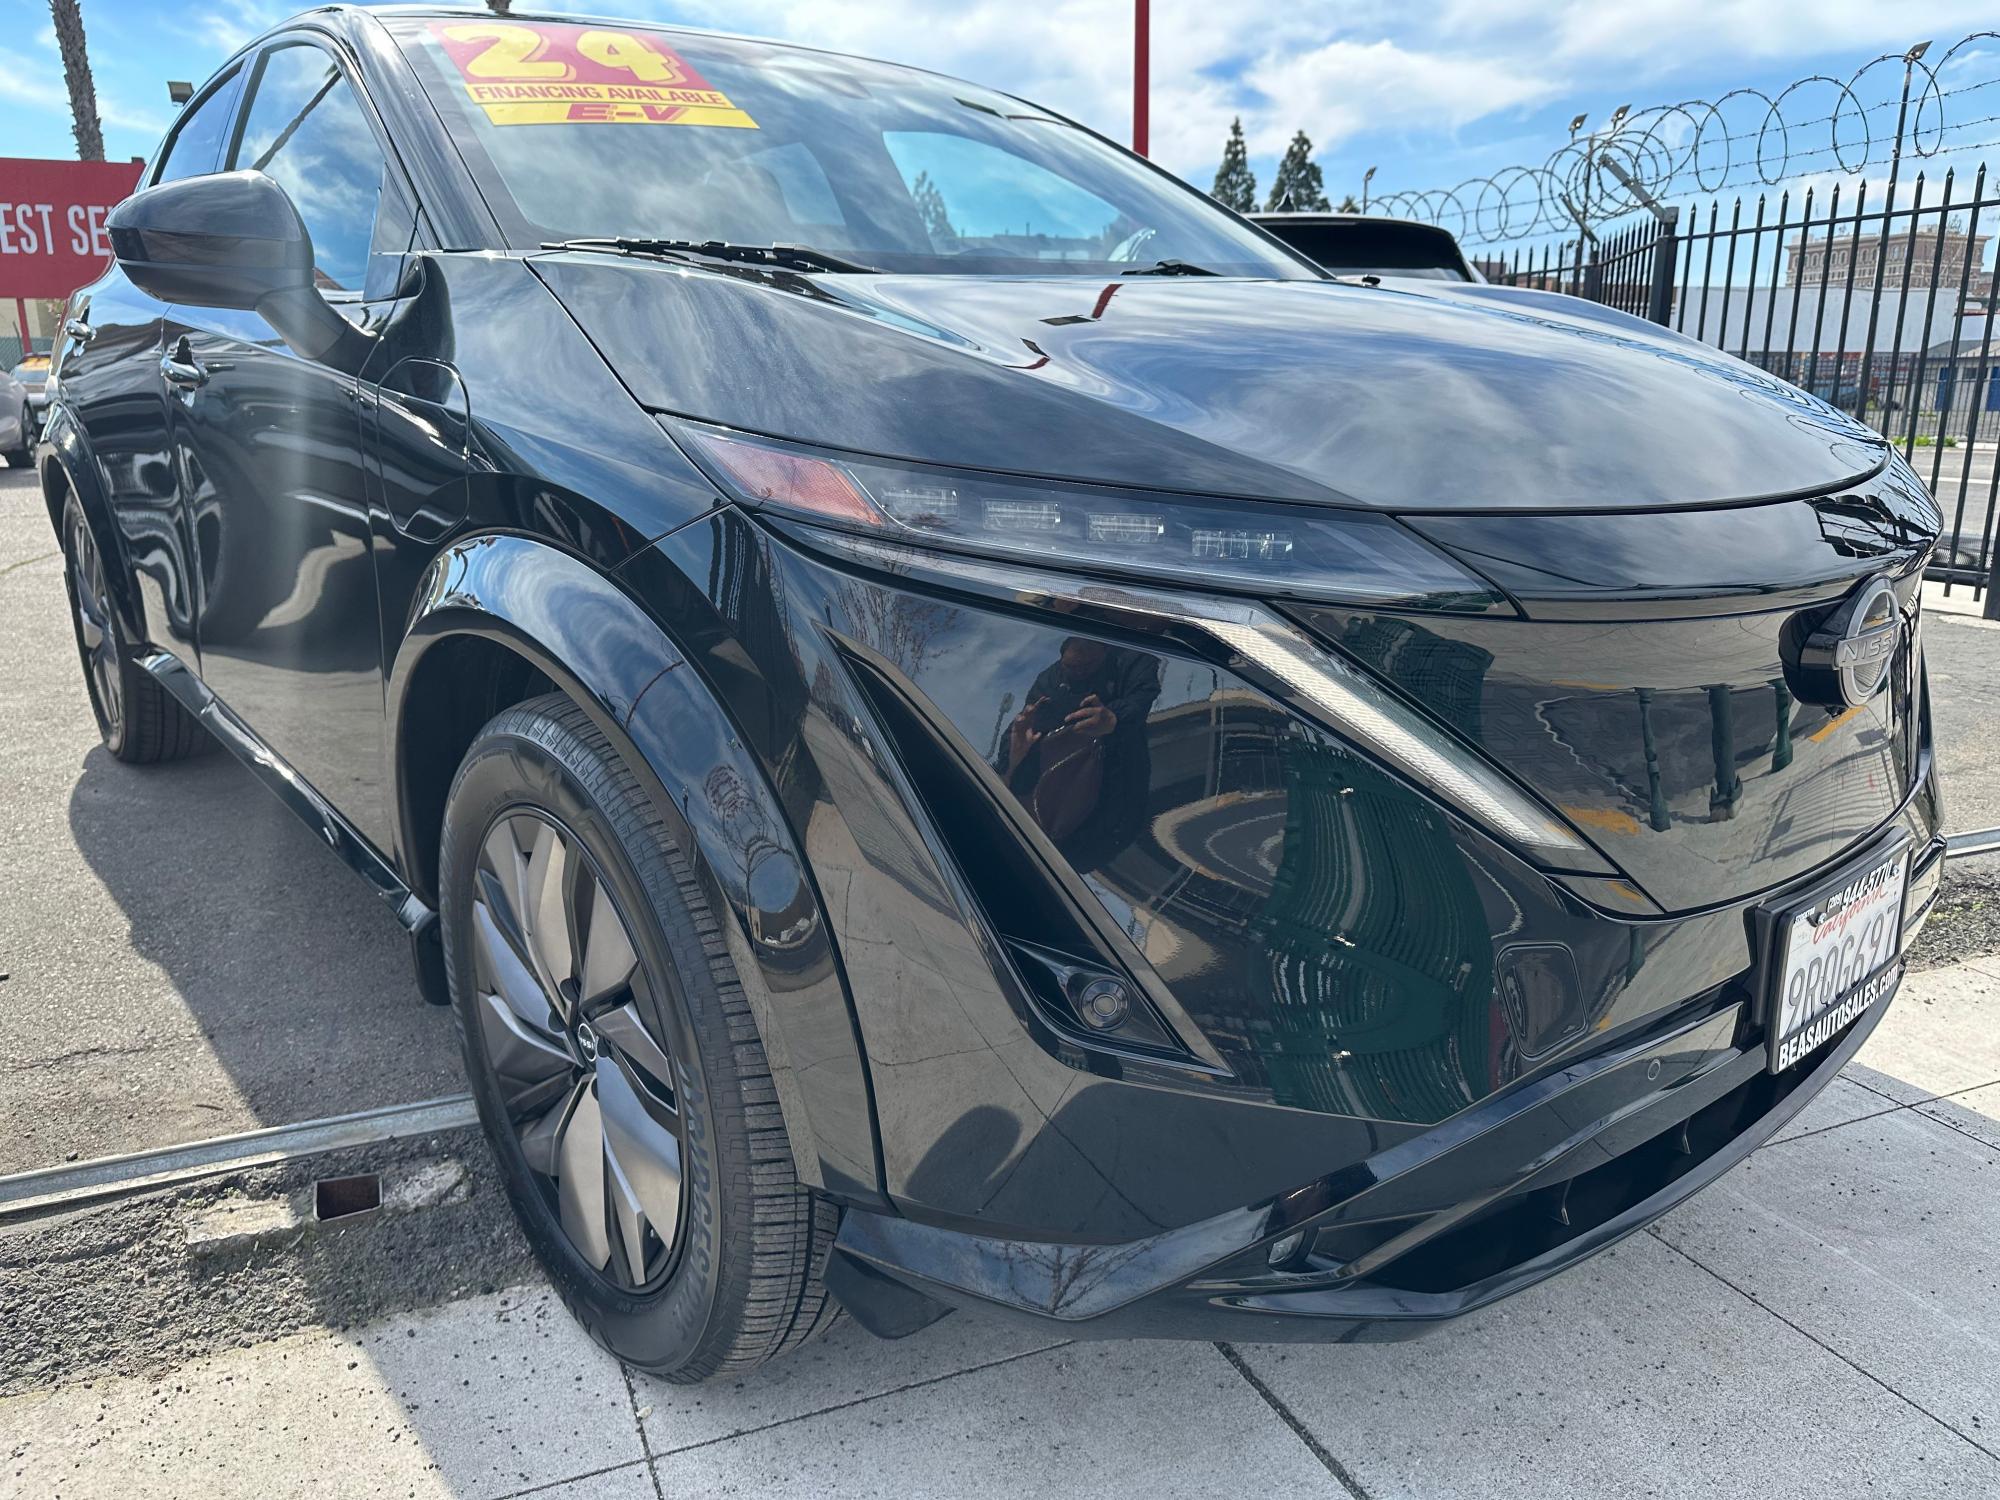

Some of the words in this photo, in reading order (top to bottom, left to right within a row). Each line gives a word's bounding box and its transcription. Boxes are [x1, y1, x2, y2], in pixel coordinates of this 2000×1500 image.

[442, 24, 687, 85] 24
[474, 86, 602, 99] FINANCING
[608, 87, 723, 106] AVAILABLE
[565, 103, 690, 121] E-V
[67, 204, 113, 256] SE
